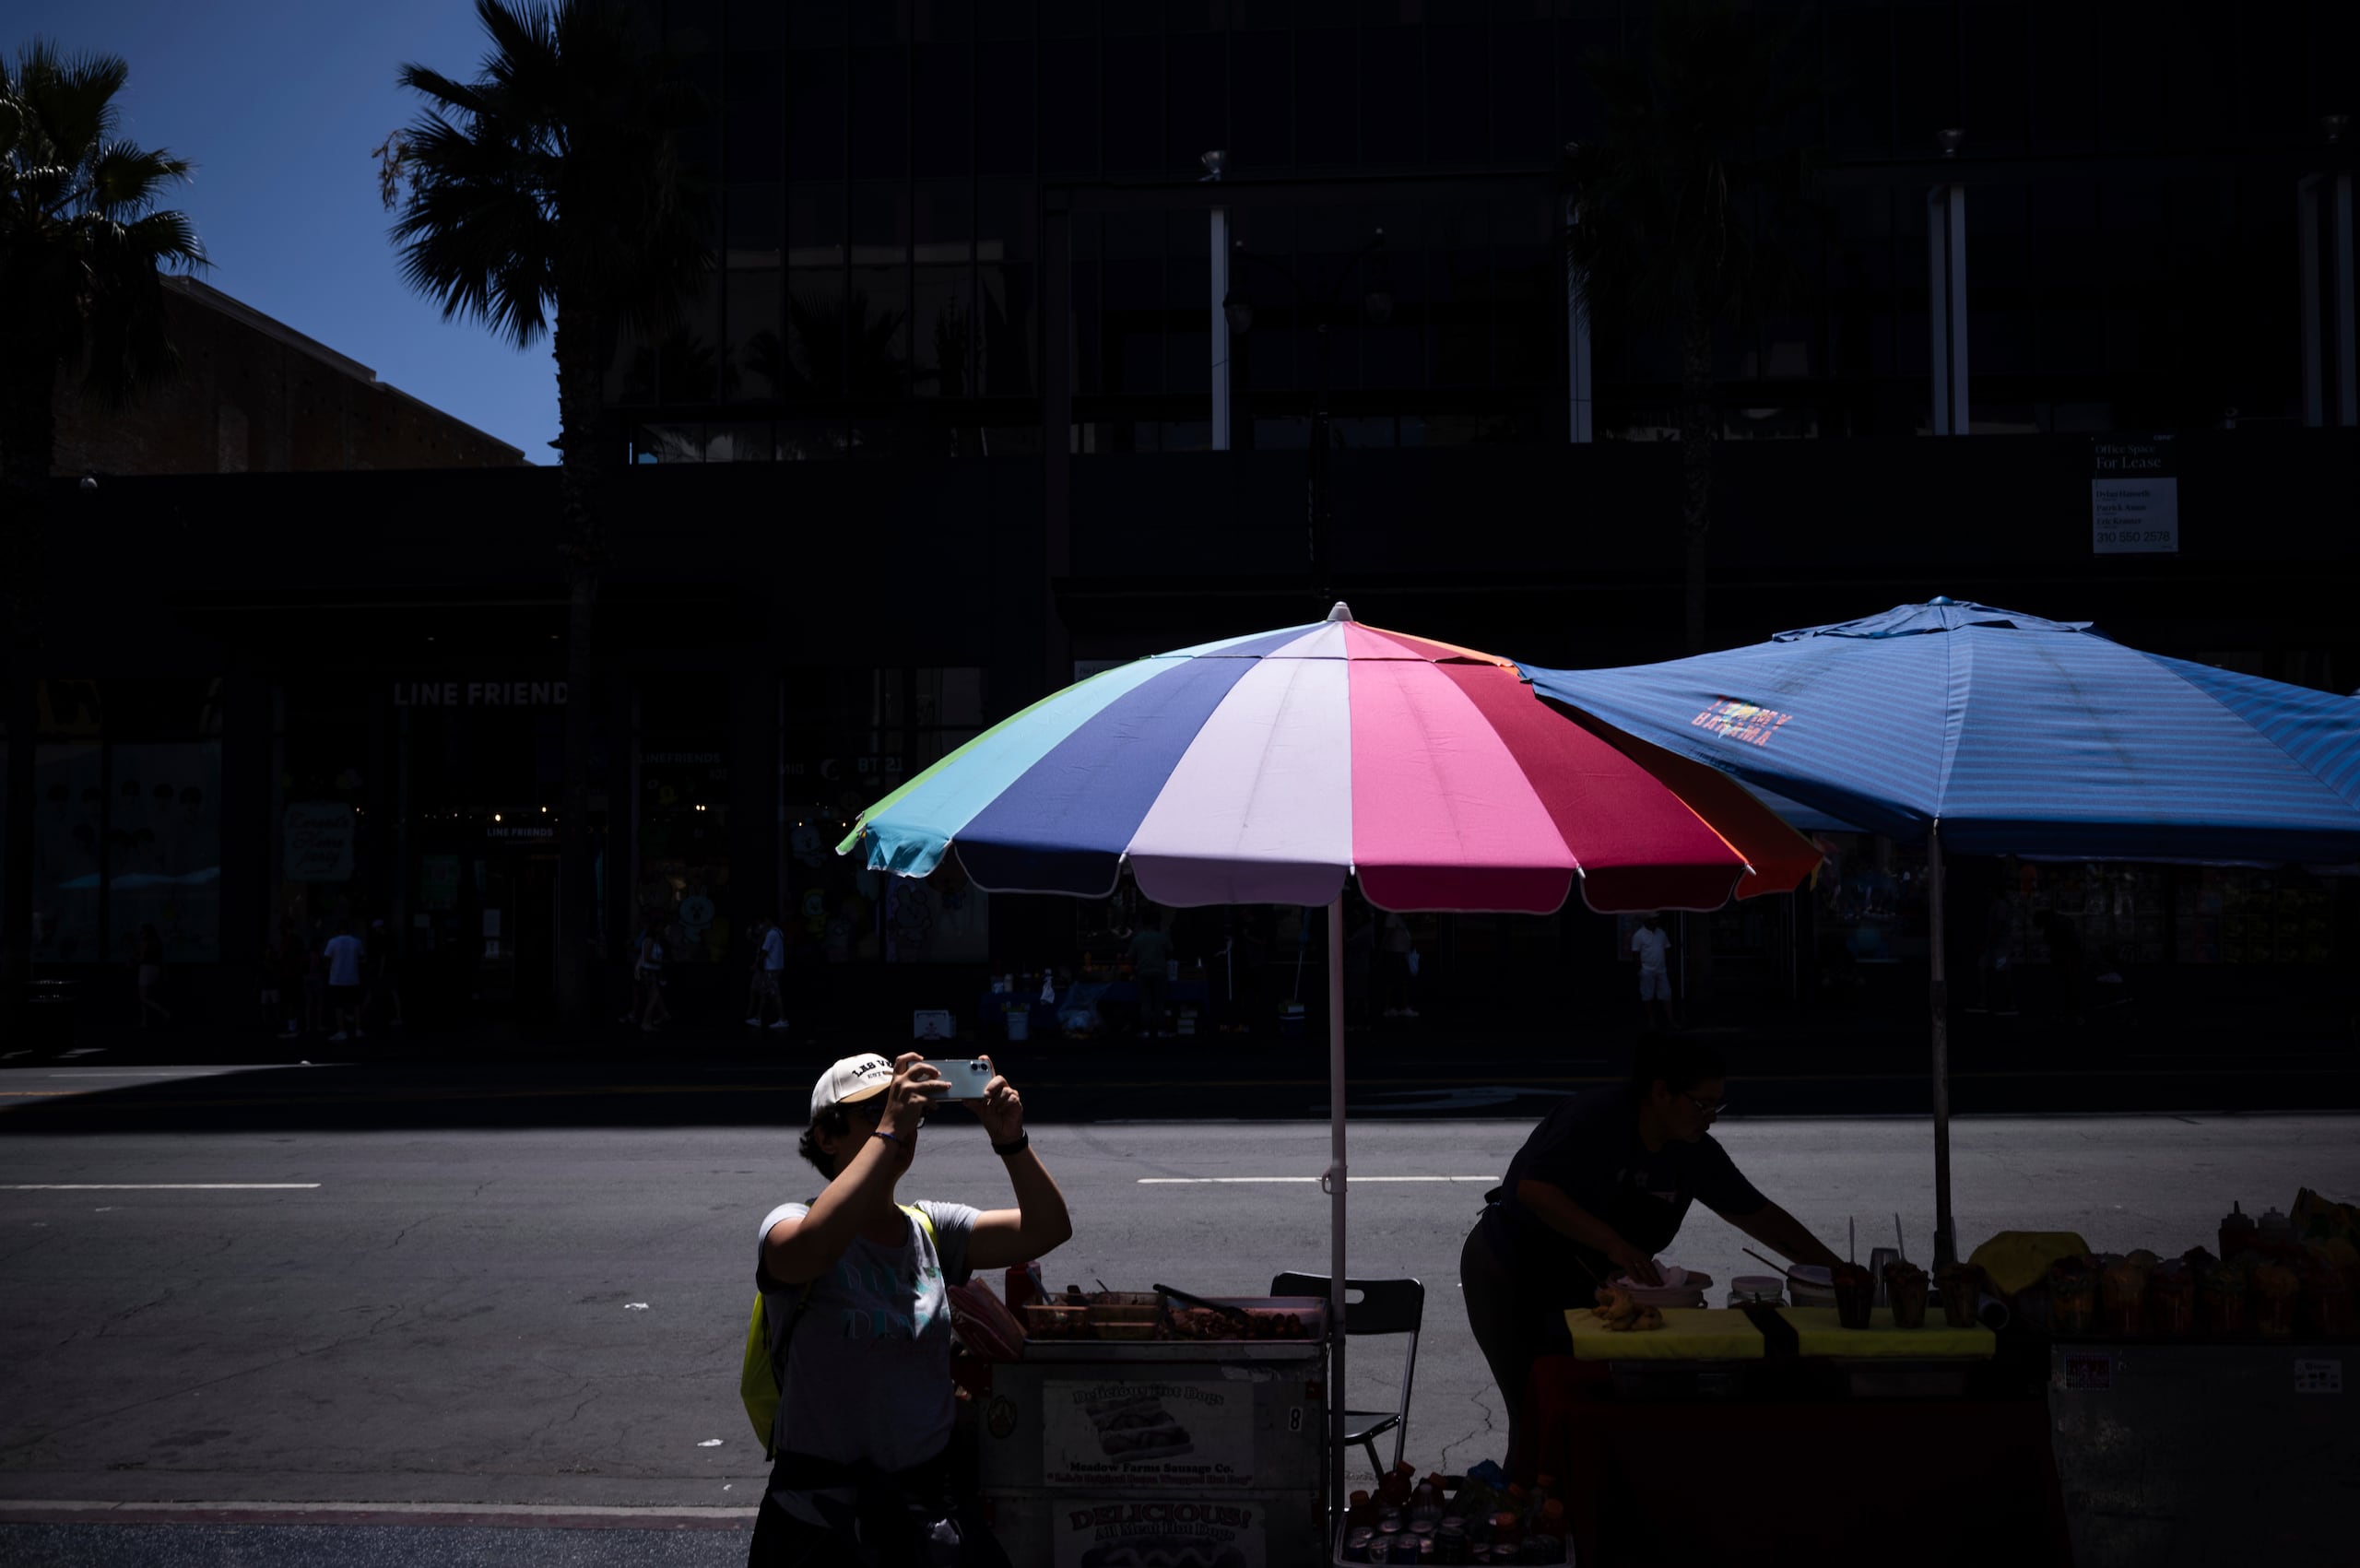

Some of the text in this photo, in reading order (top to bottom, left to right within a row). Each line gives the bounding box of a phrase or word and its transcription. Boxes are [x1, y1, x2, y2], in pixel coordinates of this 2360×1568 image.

[2094, 444, 2126, 455] Office
[2096, 456, 2162, 469] For Lease
[2096, 530, 2170, 543] 310 550 2578
[394, 682, 569, 706] LINE FRIEND
[487, 827, 554, 837] LINE FRIENDS
[852, 1061, 877, 1078] LAS
[1072, 1385, 1150, 1404] Delicious
[1185, 1386, 1226, 1406] Dogs
[1291, 1409, 1301, 1430] 8
[1069, 1462, 1234, 1474] Meadow Farms Sausage Co.
[1069, 1503, 1253, 1531] DELICIOUS!
[1094, 1521, 1236, 1542] All Meat Hot Dogs
